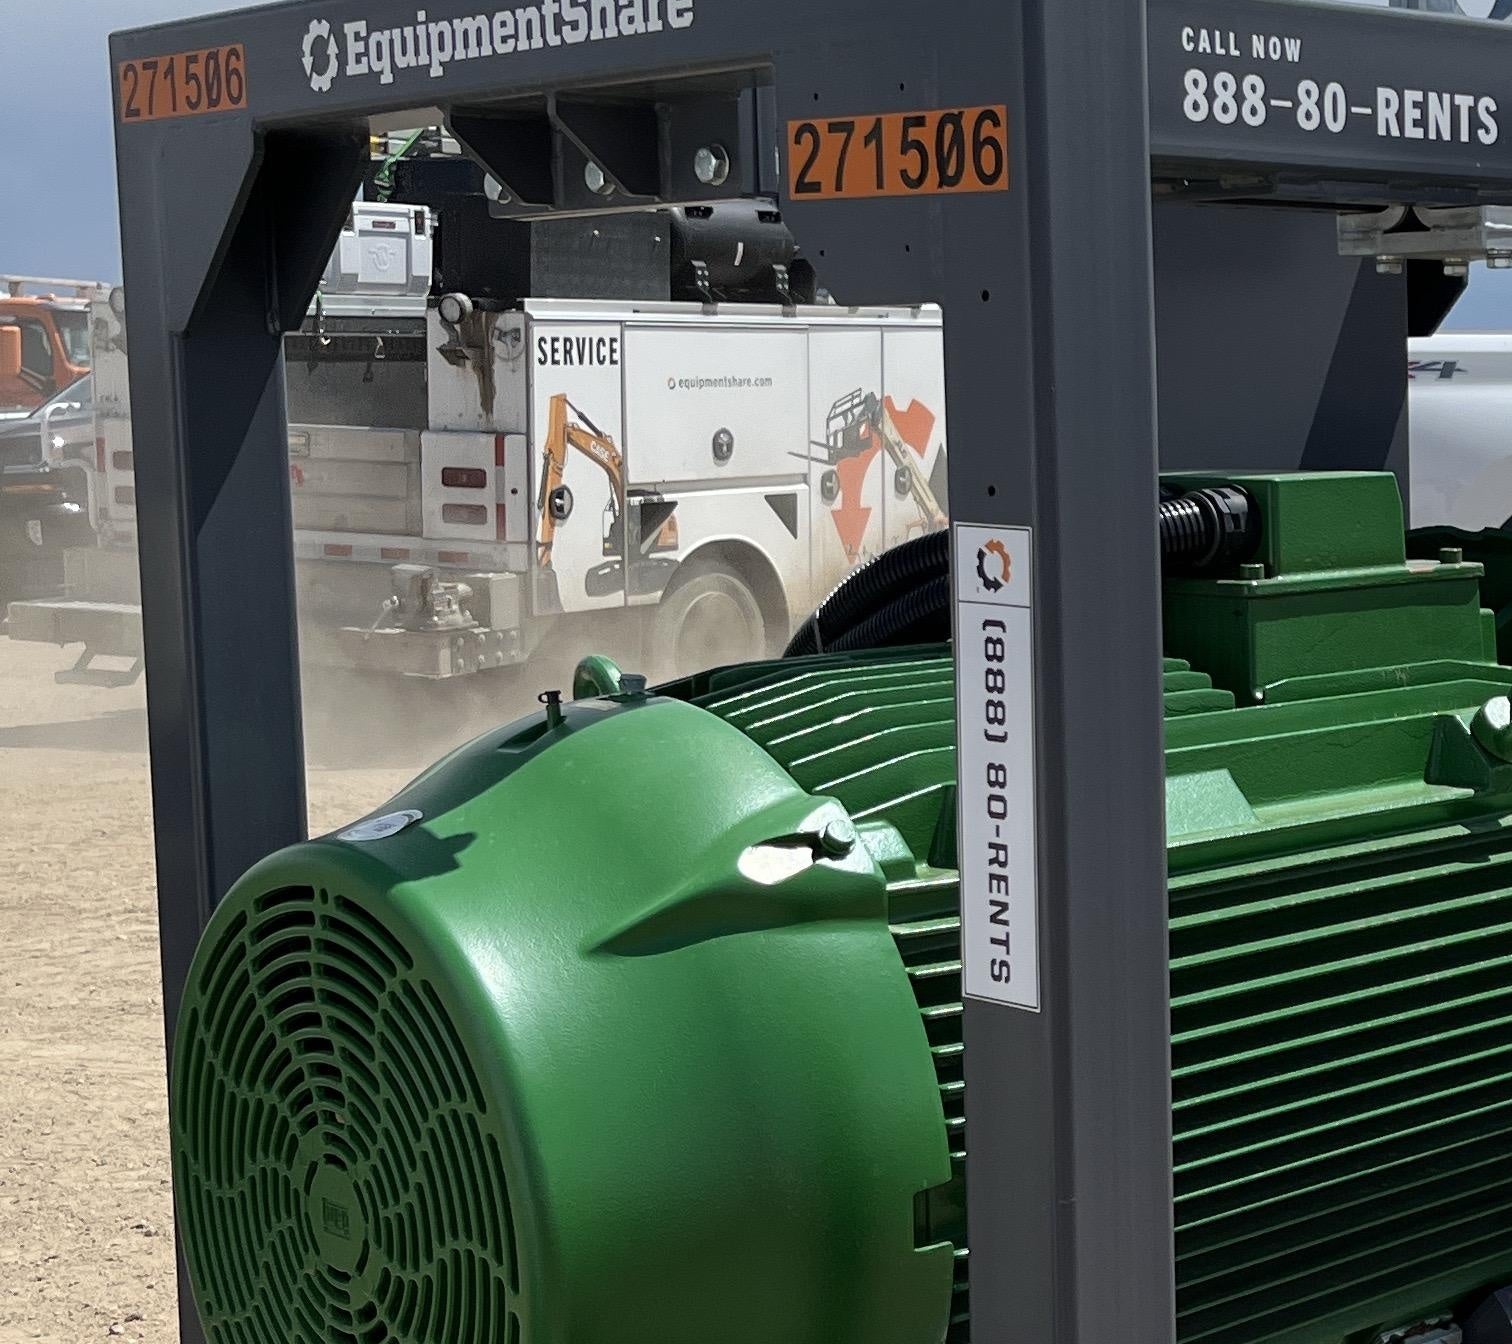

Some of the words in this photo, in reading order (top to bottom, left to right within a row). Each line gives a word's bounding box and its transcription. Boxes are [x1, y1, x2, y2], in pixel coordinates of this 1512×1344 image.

[1182, 26, 1240, 57] CALL
[1252, 34, 1301, 63] NOW
[123, 47, 243, 118] 271506
[1183, 68, 1498, 145] 888-80-RENTS
[794, 109, 1003, 194] 271506
[537, 336, 618, 366] SERVICE
[678, 376, 773, 390] equipmentshare.com
[983, 619, 1008, 744] (888)
[986, 761, 1011, 985] 80-RENTS
